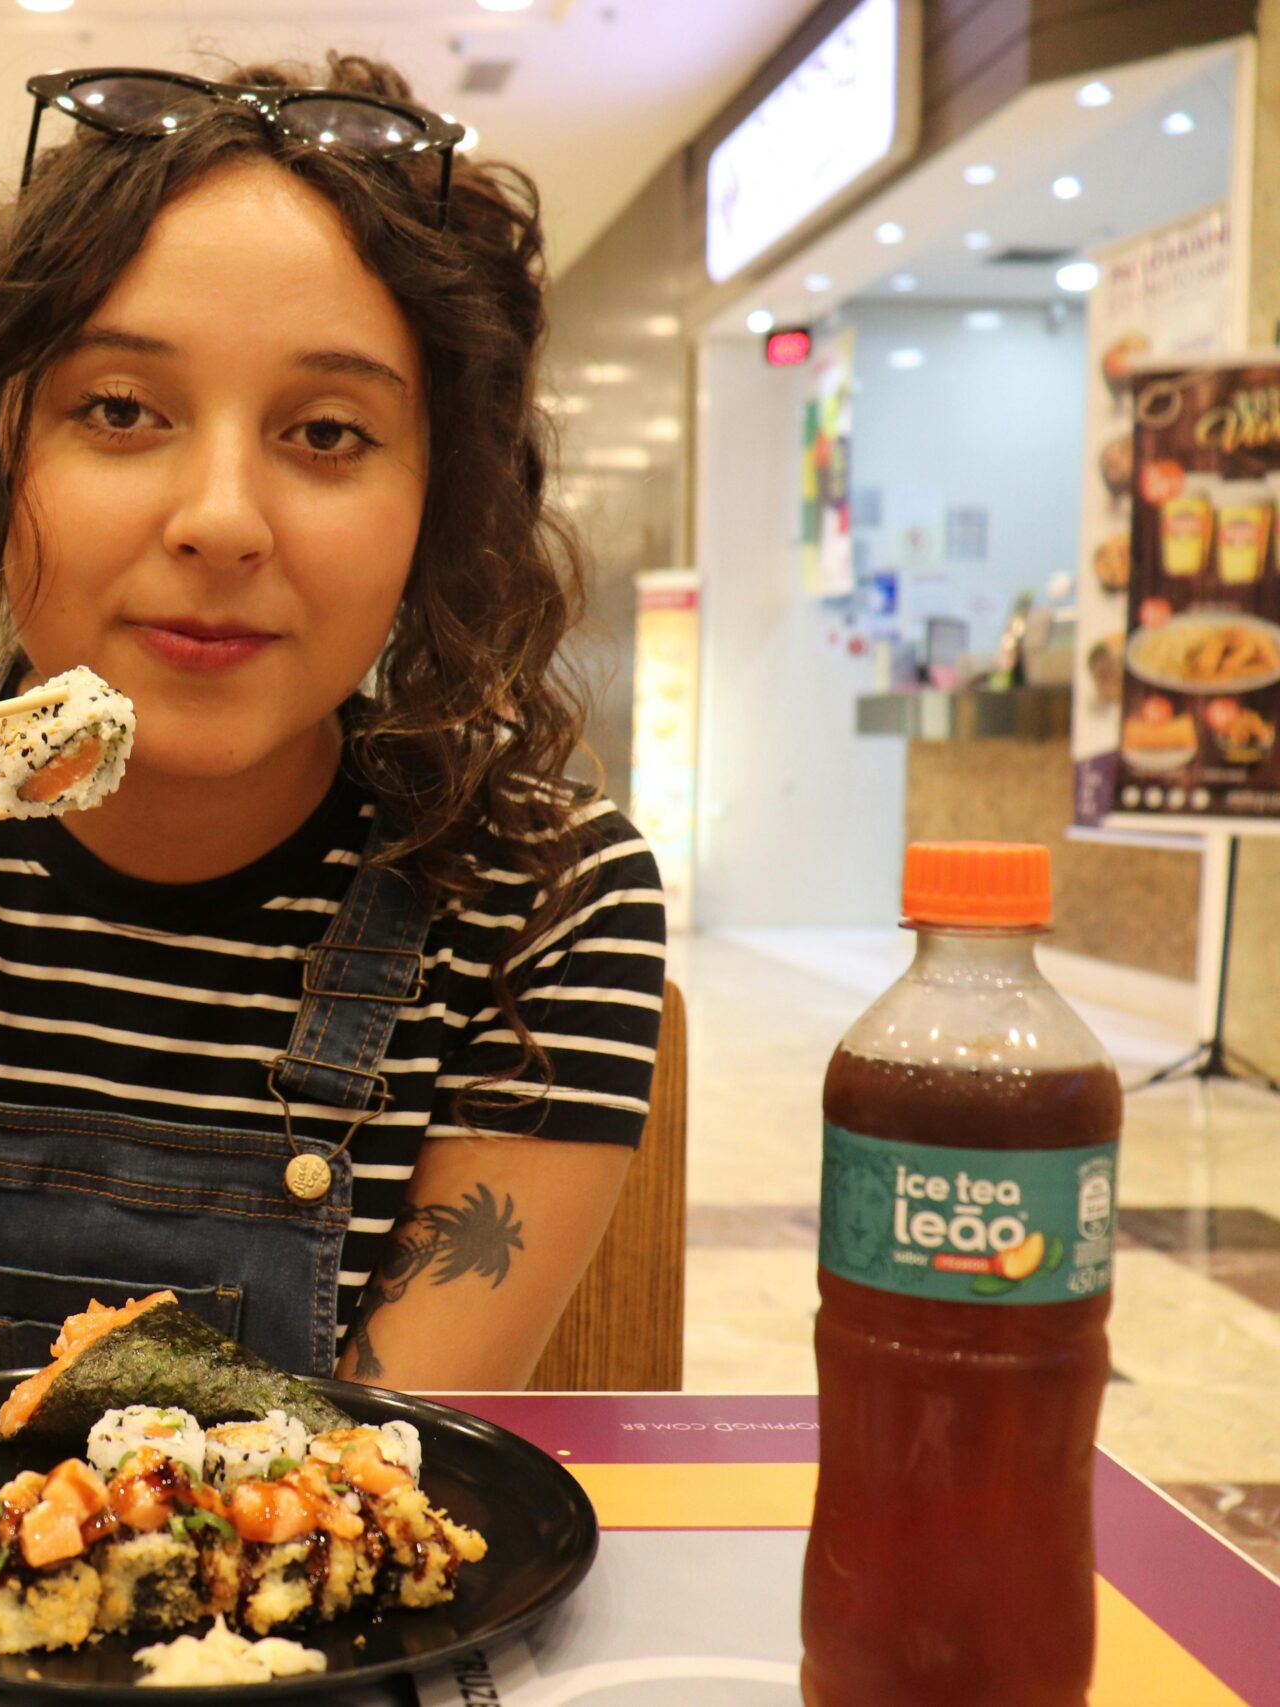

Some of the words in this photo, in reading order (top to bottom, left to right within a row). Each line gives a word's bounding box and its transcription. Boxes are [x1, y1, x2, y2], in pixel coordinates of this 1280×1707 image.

[895, 1165, 950, 1202] ice
[955, 1171, 1021, 1206] tea
[893, 1197, 1026, 1252] leão
[453, 1650, 502, 1707] RUZ
